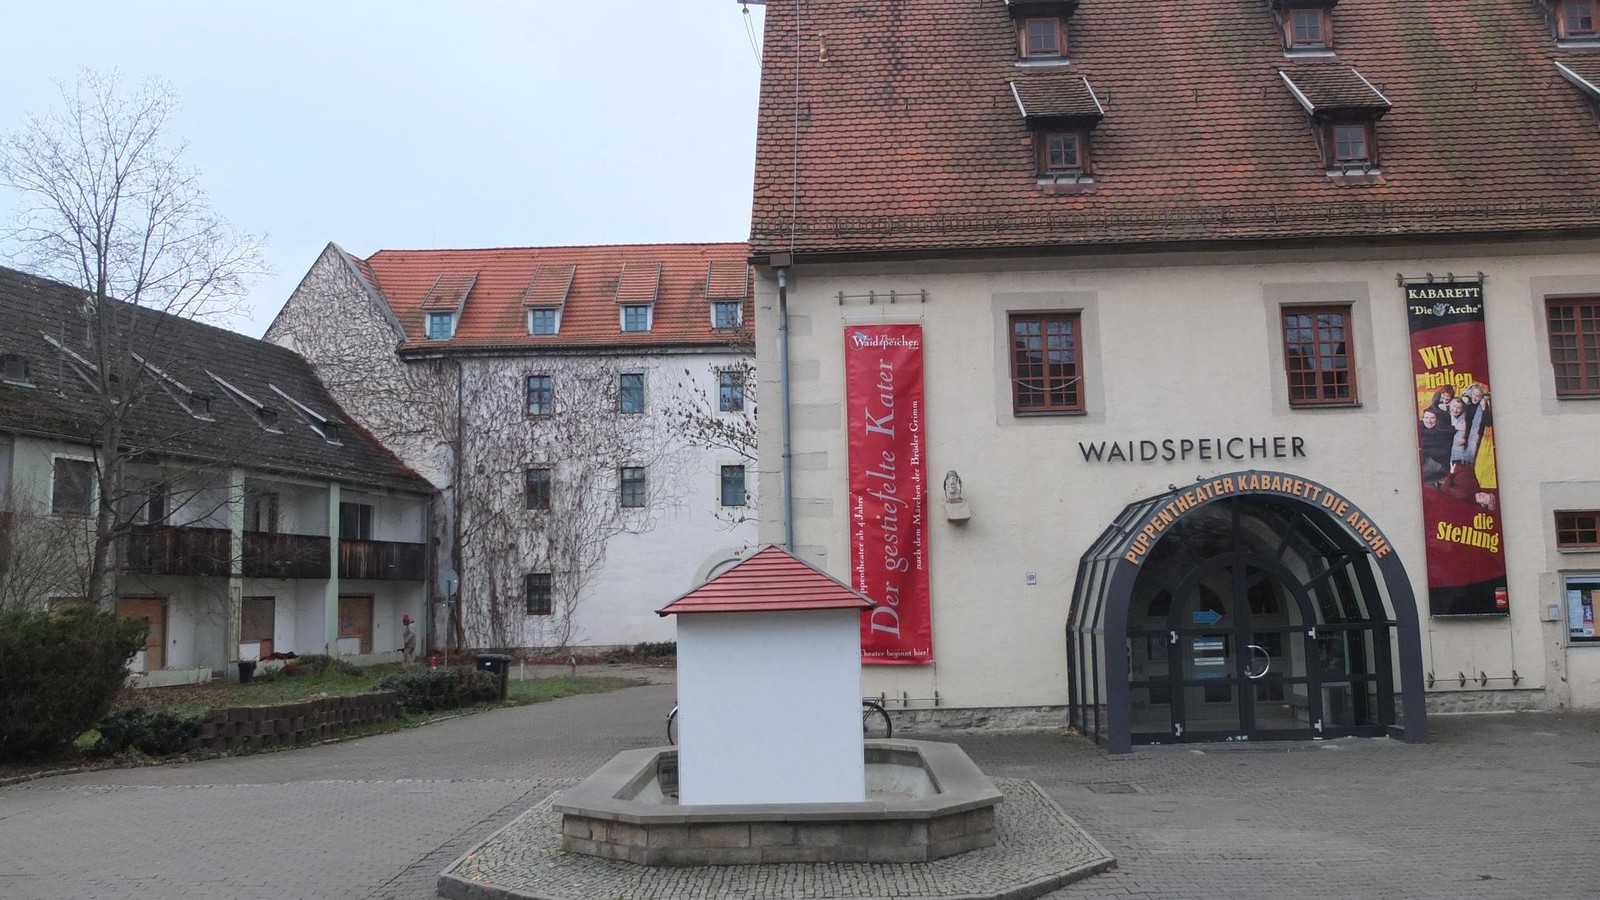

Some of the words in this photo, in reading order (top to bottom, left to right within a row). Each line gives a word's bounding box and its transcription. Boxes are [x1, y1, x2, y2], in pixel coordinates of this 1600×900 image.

[1408, 287, 1480, 299] KABARETT
[1418, 345, 1454, 370] Wir
[1425, 368, 1473, 389] halten
[865, 358, 895, 440] Kater
[909, 400, 919, 432] Grimm
[910, 434, 920, 466] Brüder
[1078, 436, 1307, 463] WAIDSPEICHER
[911, 468, 921, 482] der
[854, 495, 864, 521] Jahre
[866, 450, 909, 573] gestiefelte
[912, 484, 921, 526] Märchen
[1125, 477, 1234, 565] PUPPENTHEATER
[1237, 474, 1322, 502] KABARETT
[1321, 491, 1350, 517] DIE
[1346, 512, 1392, 558] ARCHE
[1473, 513, 1494, 530] die
[855, 530, 864, 541] ab
[913, 528, 921, 547] dem
[1436, 521, 1499, 553] Stellung
[855, 542, 868, 594] ppentheater
[913, 549, 922, 570] nach
[871, 581, 900, 640] Der
[913, 647, 929, 656] hier!
